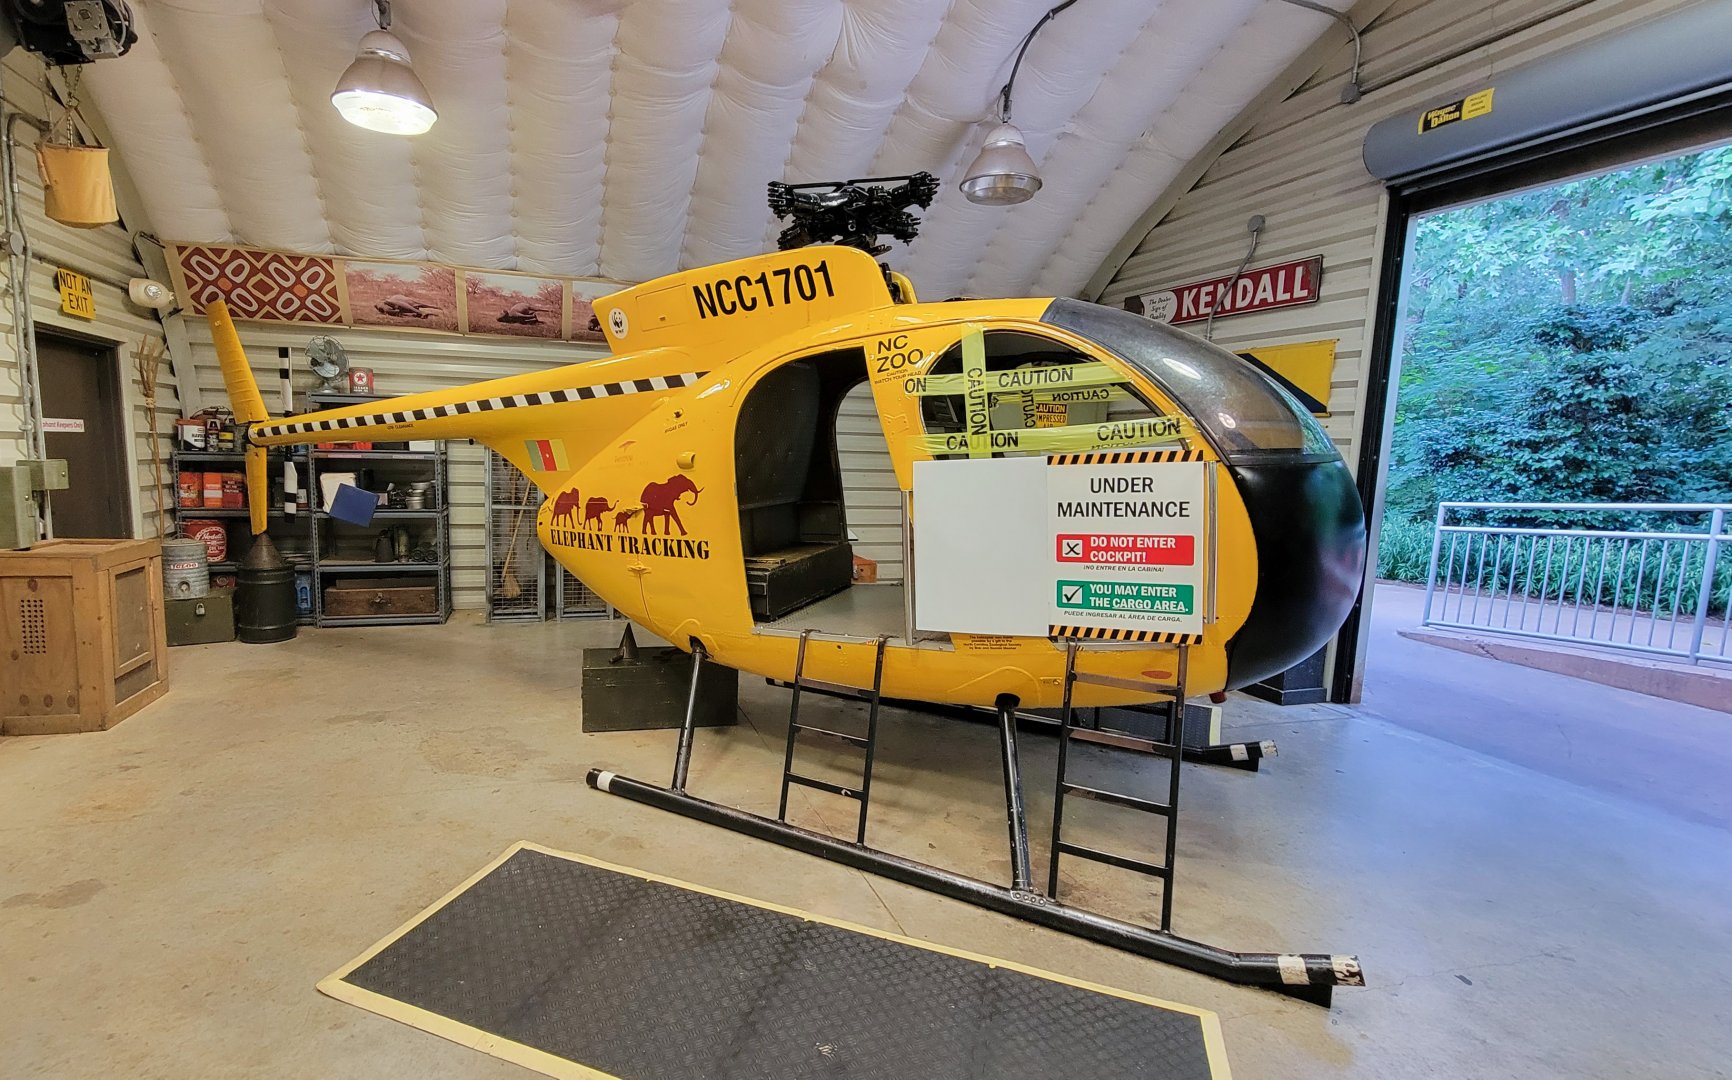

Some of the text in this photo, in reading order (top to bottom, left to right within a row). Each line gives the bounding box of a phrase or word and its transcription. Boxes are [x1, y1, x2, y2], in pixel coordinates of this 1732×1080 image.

[1431, 112, 1460, 128] Dalton
[59, 271, 92, 296] NOT AN
[692, 259, 835, 319] NCC1701
[1181, 266, 1308, 318] KENDALL
[68, 293, 89, 313] EXIT
[877, 335, 908, 354] NC
[876, 348, 924, 373] ZOO
[998, 366, 1073, 388] CAUTION
[967, 368, 988, 436] CAUTION
[1036, 414, 1066, 423] MPRESSED
[1097, 418, 1181, 441] CAUTION
[1090, 477, 1154, 493] UNDER
[1057, 501, 1190, 517] MAINTENANCE
[551, 529, 710, 560] ELEPHANT TRACKING
[1090, 536, 1176, 548] DO NOT ENTER
[1090, 551, 1146, 562] COCKPIT!
[1090, 584, 1177, 597] YOU MAY ENTER
[1090, 597, 1189, 612] THE CARGO AREA.
